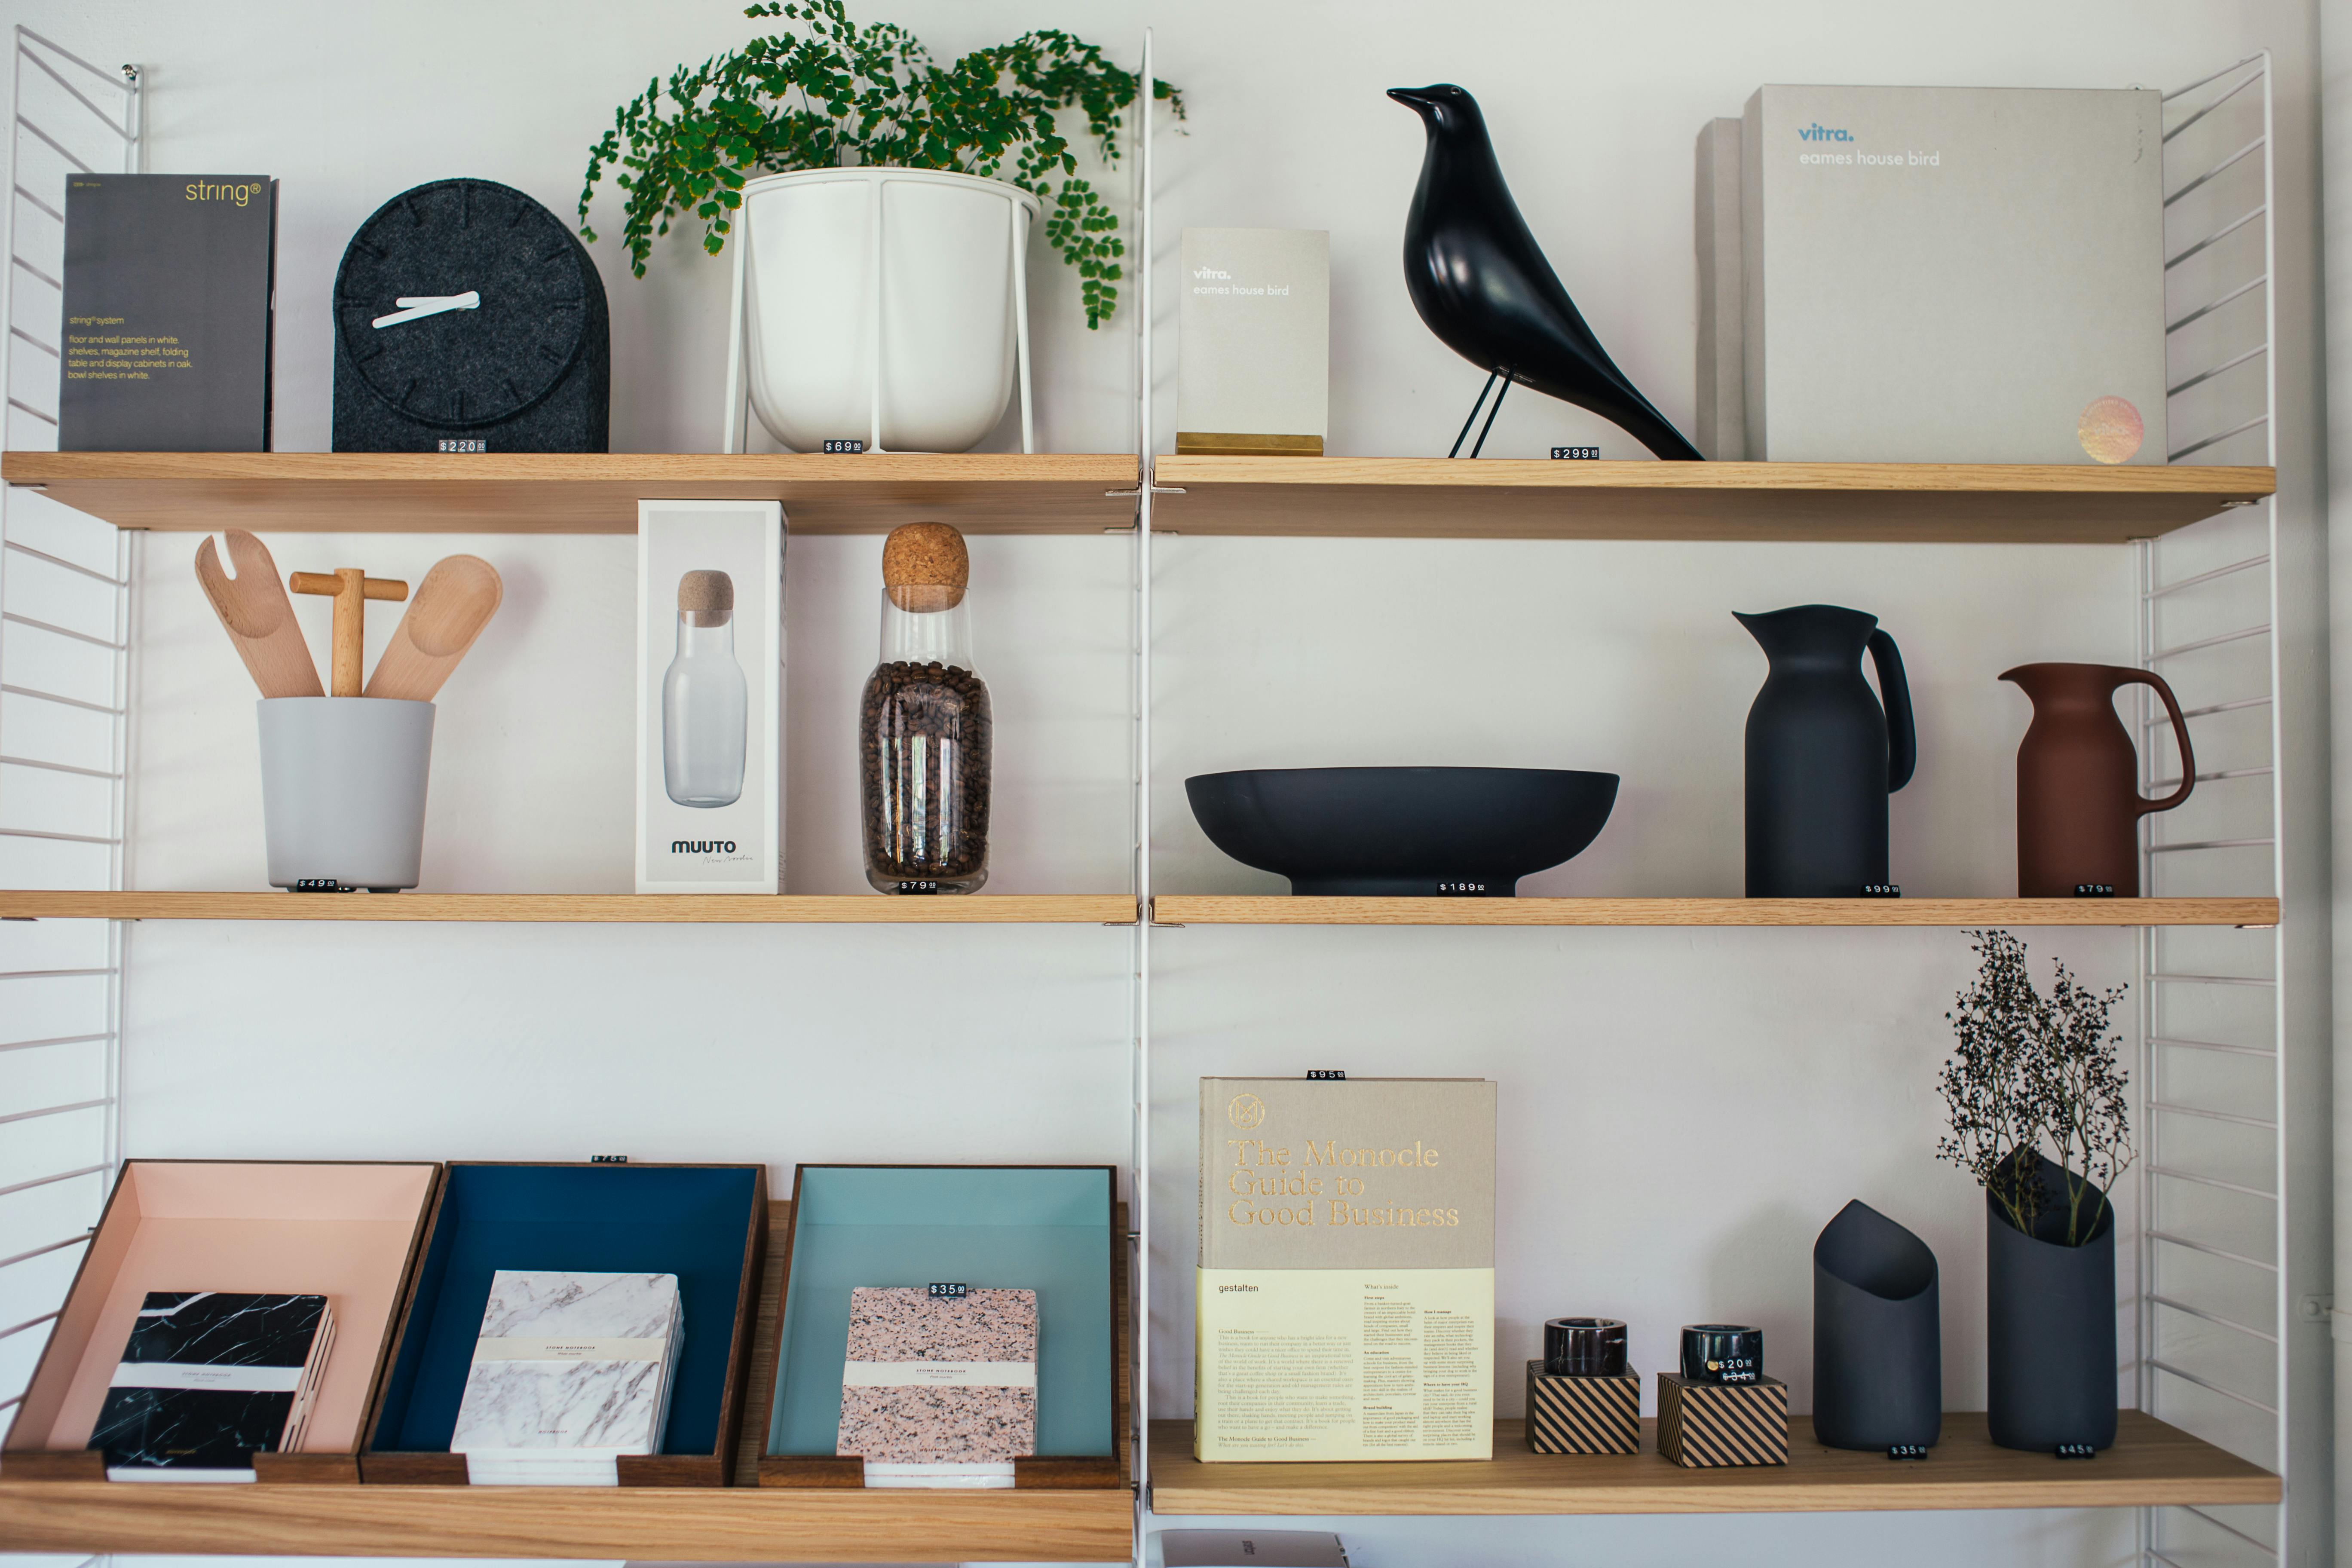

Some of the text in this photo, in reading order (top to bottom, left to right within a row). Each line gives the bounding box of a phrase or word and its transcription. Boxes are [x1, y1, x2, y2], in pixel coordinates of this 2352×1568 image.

[1798, 122, 1854, 142] vitra.
[1800, 150, 1939, 166] eames house bird
[1193, 266, 1231, 279] vitra.
[1233, 284, 1264, 294] house
[1268, 285, 1289, 295] bird
[69, 335, 86, 344] floor
[121, 336, 147, 345] panels
[156, 336, 180, 344] white.
[68, 348, 189, 358] shelves, magazine shelf, folding
[106, 359, 132, 369] display
[177, 360, 193, 368] oak.
[1228, 1140, 1439, 1167] The Monocle
[1228, 1169, 1364, 1196] Guide to
[1228, 1200, 1459, 1226] Good Business
[1219, 1284, 1259, 1293] gestalten
